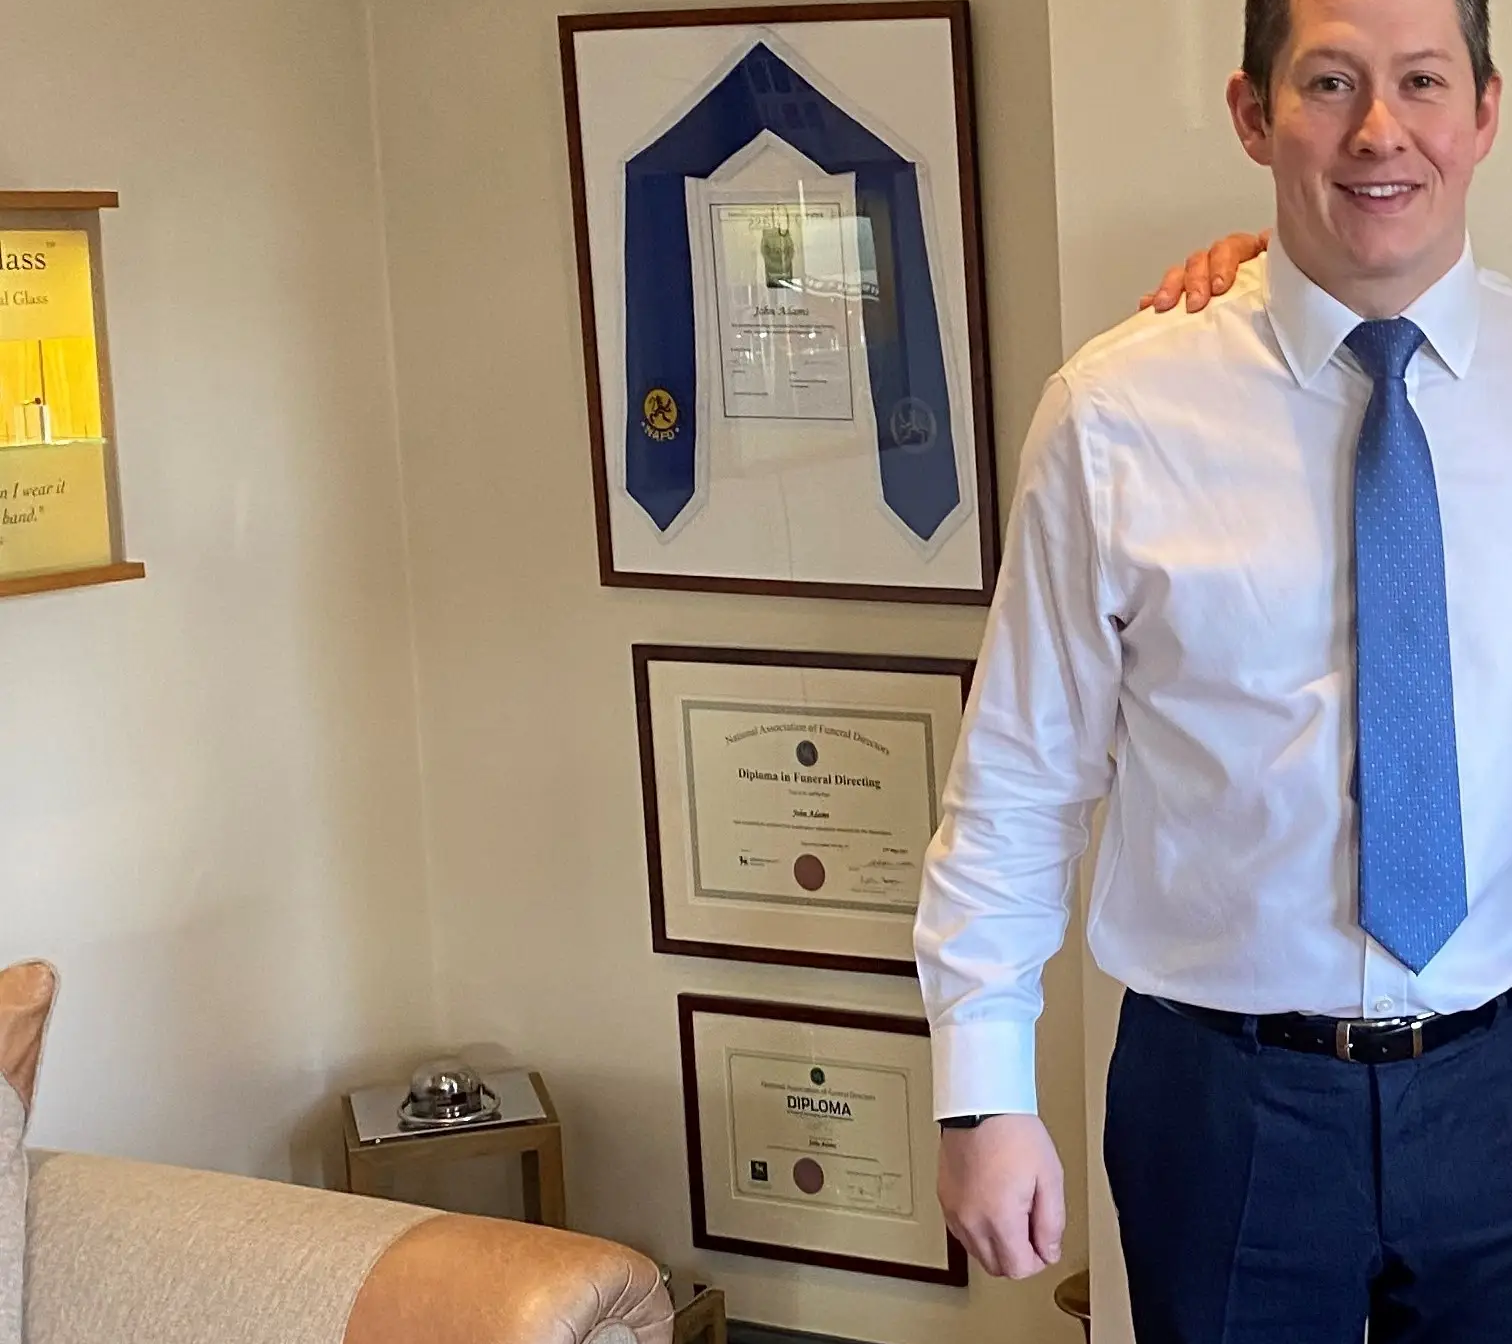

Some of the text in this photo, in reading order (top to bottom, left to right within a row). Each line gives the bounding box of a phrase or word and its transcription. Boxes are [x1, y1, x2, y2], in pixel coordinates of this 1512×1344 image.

[13, 289, 48, 305] Glass
[23, 485, 54, 497] wear
[725, 727, 759, 745] National
[819, 724, 851, 740] Funeral
[738, 768, 882, 790] Diploma in Funeral Directing
[786, 1095, 852, 1117] DIPLOMA
